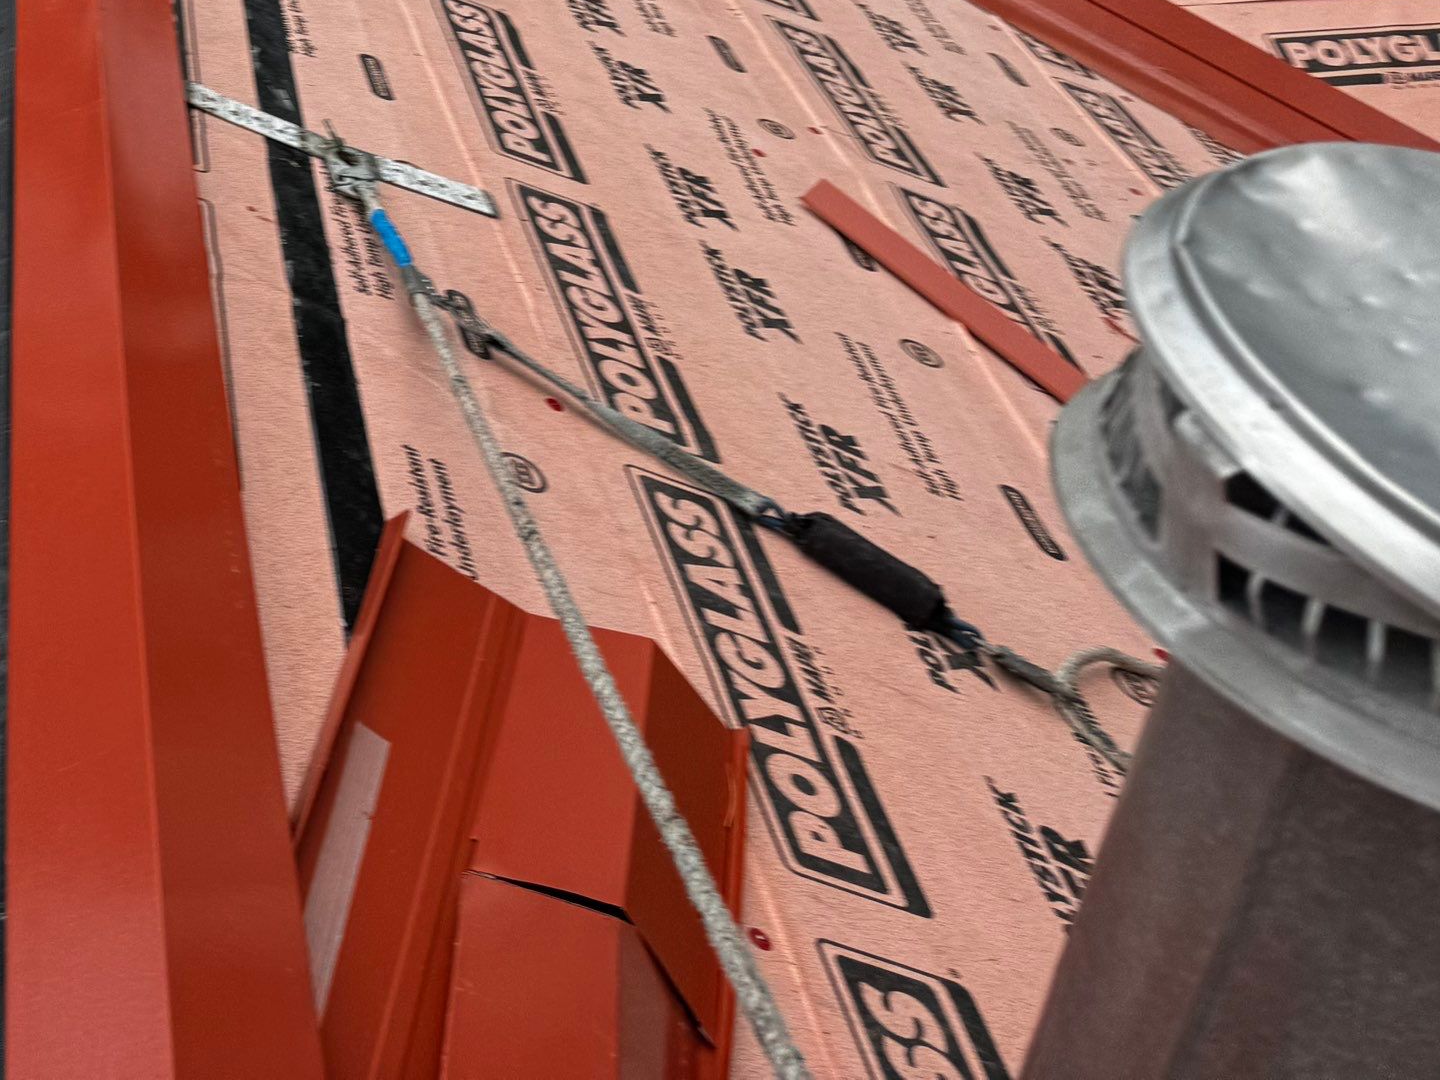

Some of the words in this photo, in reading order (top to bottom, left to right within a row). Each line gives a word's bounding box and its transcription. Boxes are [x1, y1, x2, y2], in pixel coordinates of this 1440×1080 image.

[446, 0, 547, 161] POLYGLASS
[785, 28, 910, 167] POLYGLASS
[1280, 34, 1440, 68] POLYGL
[676, 166, 736, 229] XFR
[530, 198, 670, 431] POLYGLASS
[700, 243, 767, 341] POLYSTICK
[731, 267, 799, 341] XFR
[782, 397, 865, 515] POLYSTICK
[818, 423, 898, 514] XFR
[657, 495, 865, 869] POLYGLASS
[985, 776, 1078, 922] LYSTICK
